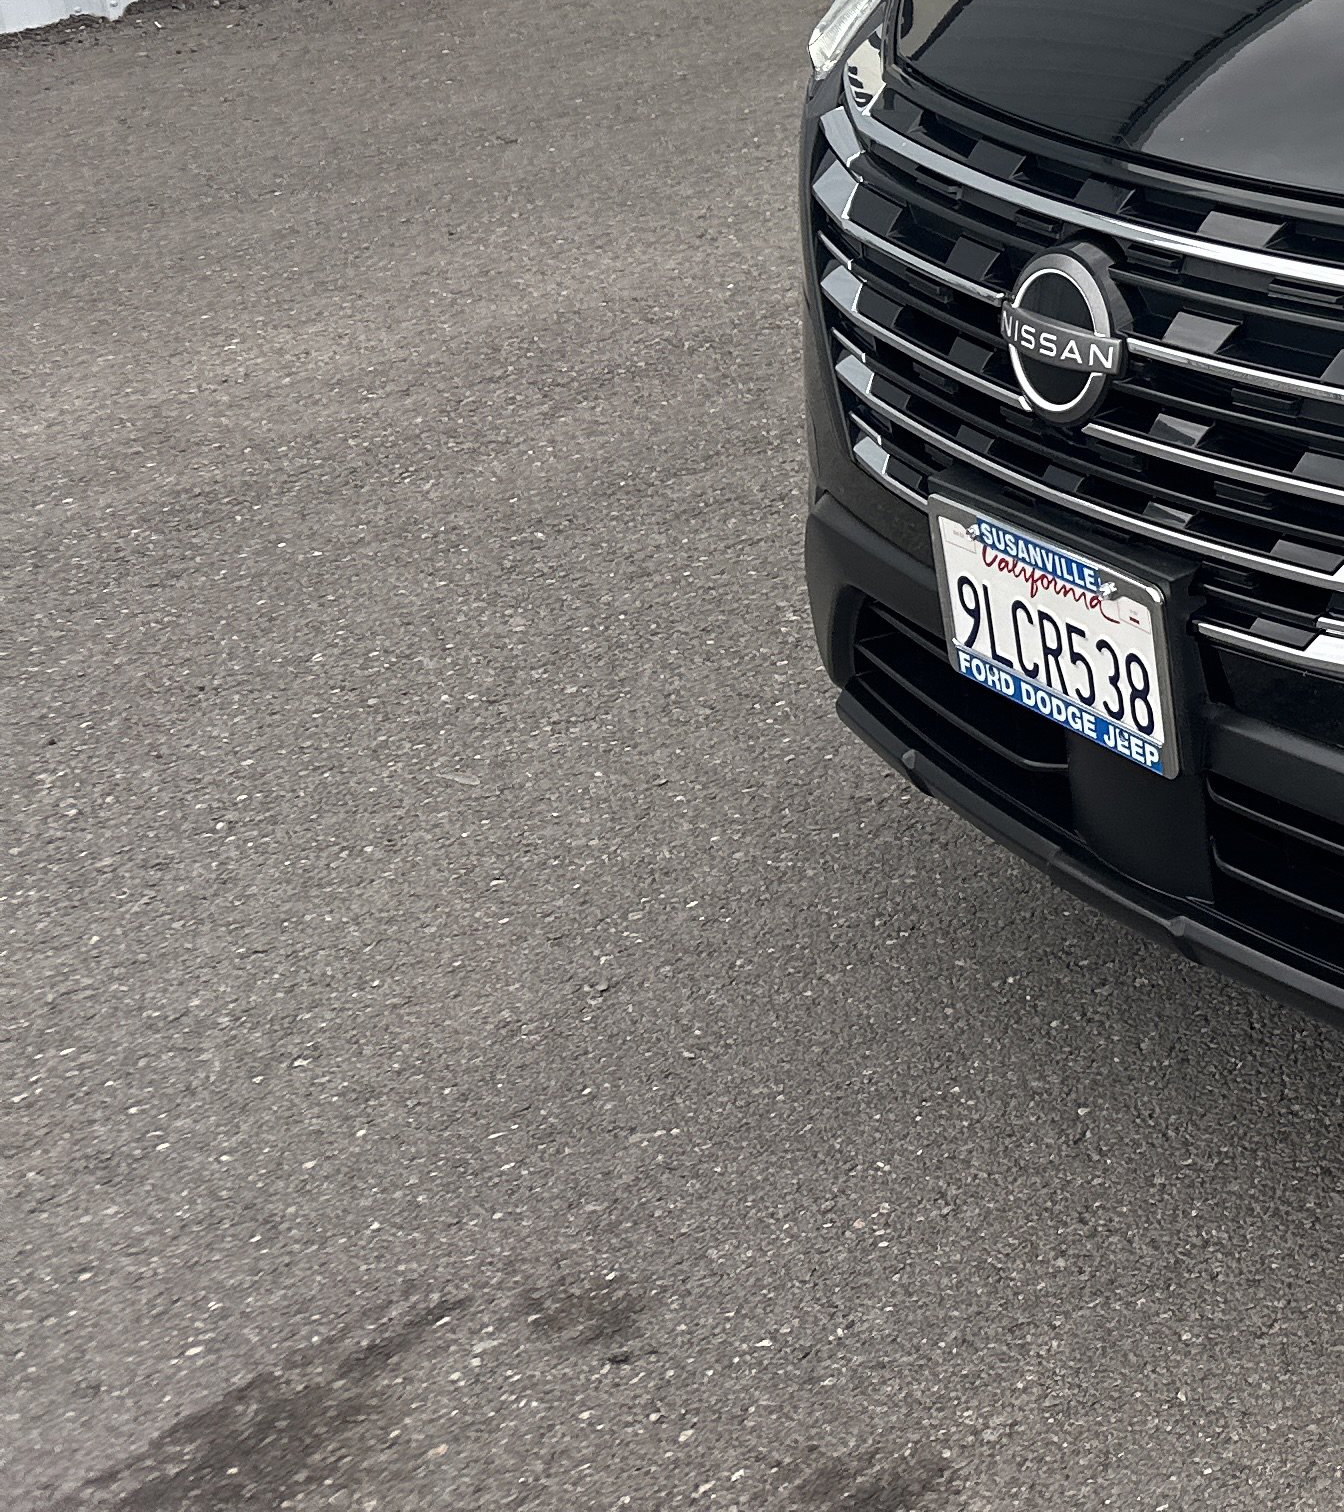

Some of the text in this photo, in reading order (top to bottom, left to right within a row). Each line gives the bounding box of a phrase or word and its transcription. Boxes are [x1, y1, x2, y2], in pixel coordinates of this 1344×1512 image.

[1003, 310, 1114, 369] NISSAN
[980, 522, 1096, 590] SUSANVILLE
[957, 575, 1154, 736] 9LCR538
[958, 652, 1161, 767] FORD DODGE JEEP
